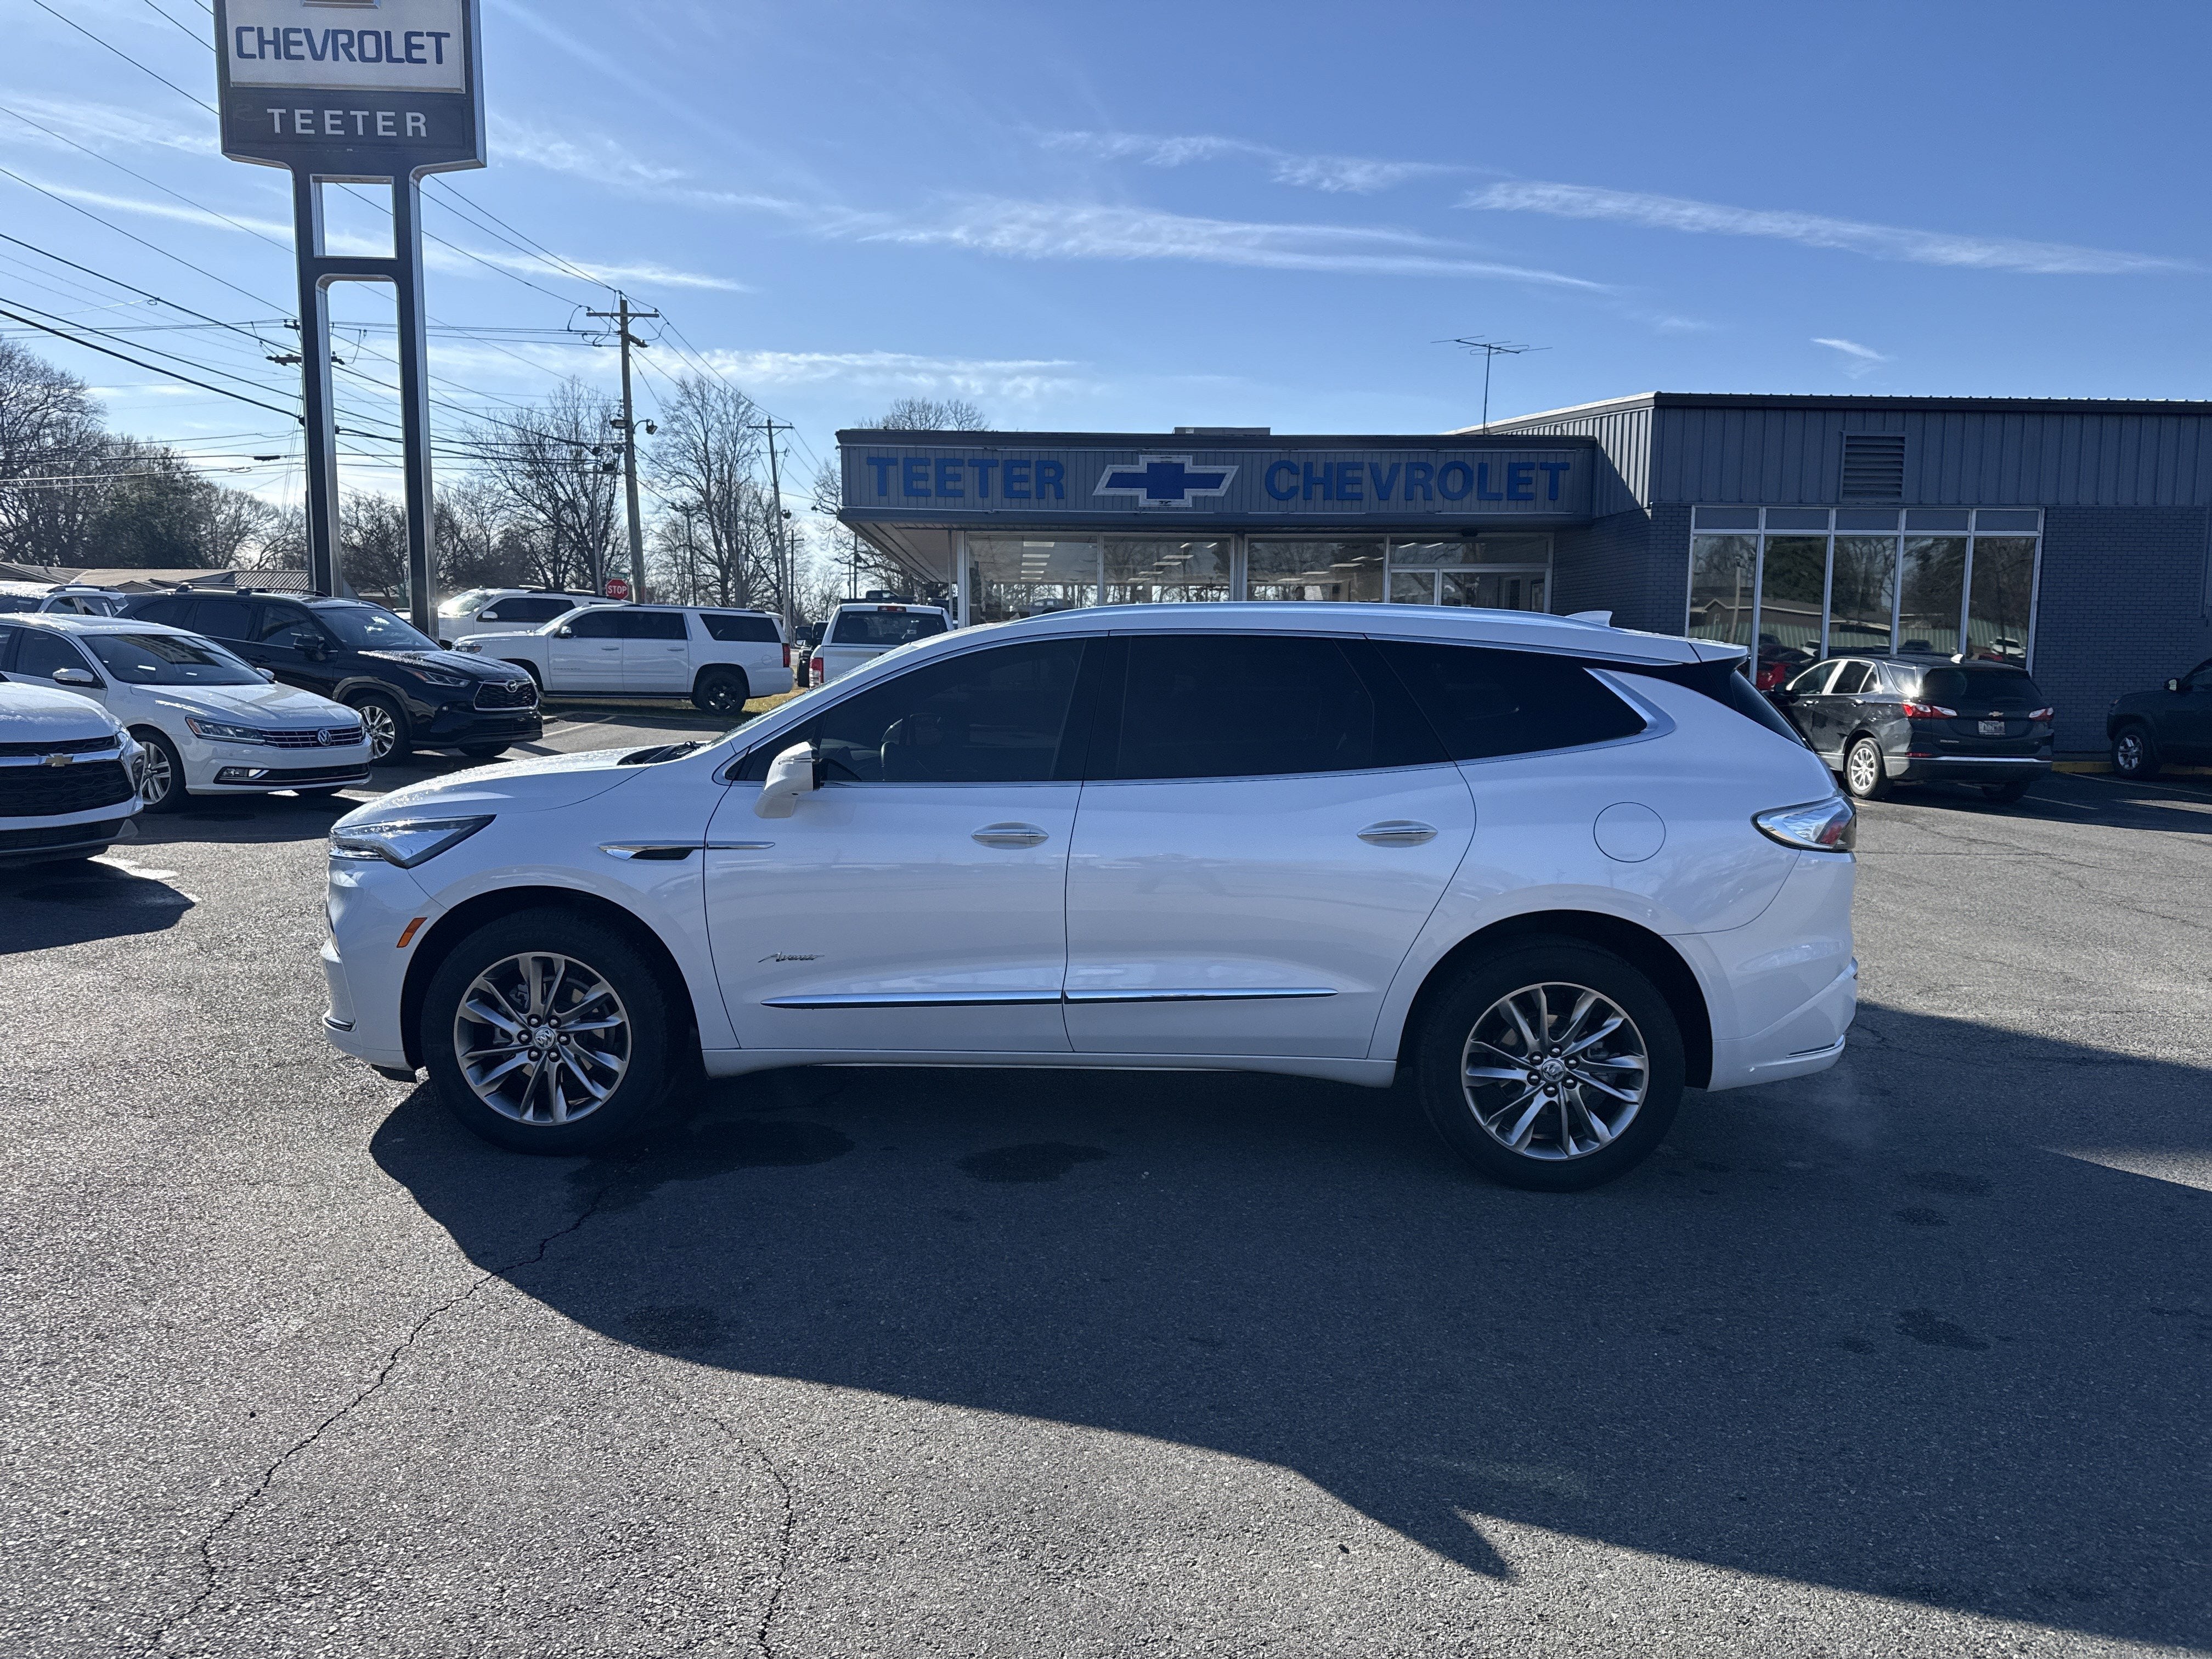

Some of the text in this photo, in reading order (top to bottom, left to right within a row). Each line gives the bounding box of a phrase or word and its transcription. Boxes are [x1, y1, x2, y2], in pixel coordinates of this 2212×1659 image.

[235, 26, 450, 64] CHEVROLET
[267, 109, 427, 137] TEETER
[866, 457, 1571, 501] TEETER CHEVROLET
[607, 585, 627, 594] STOP
